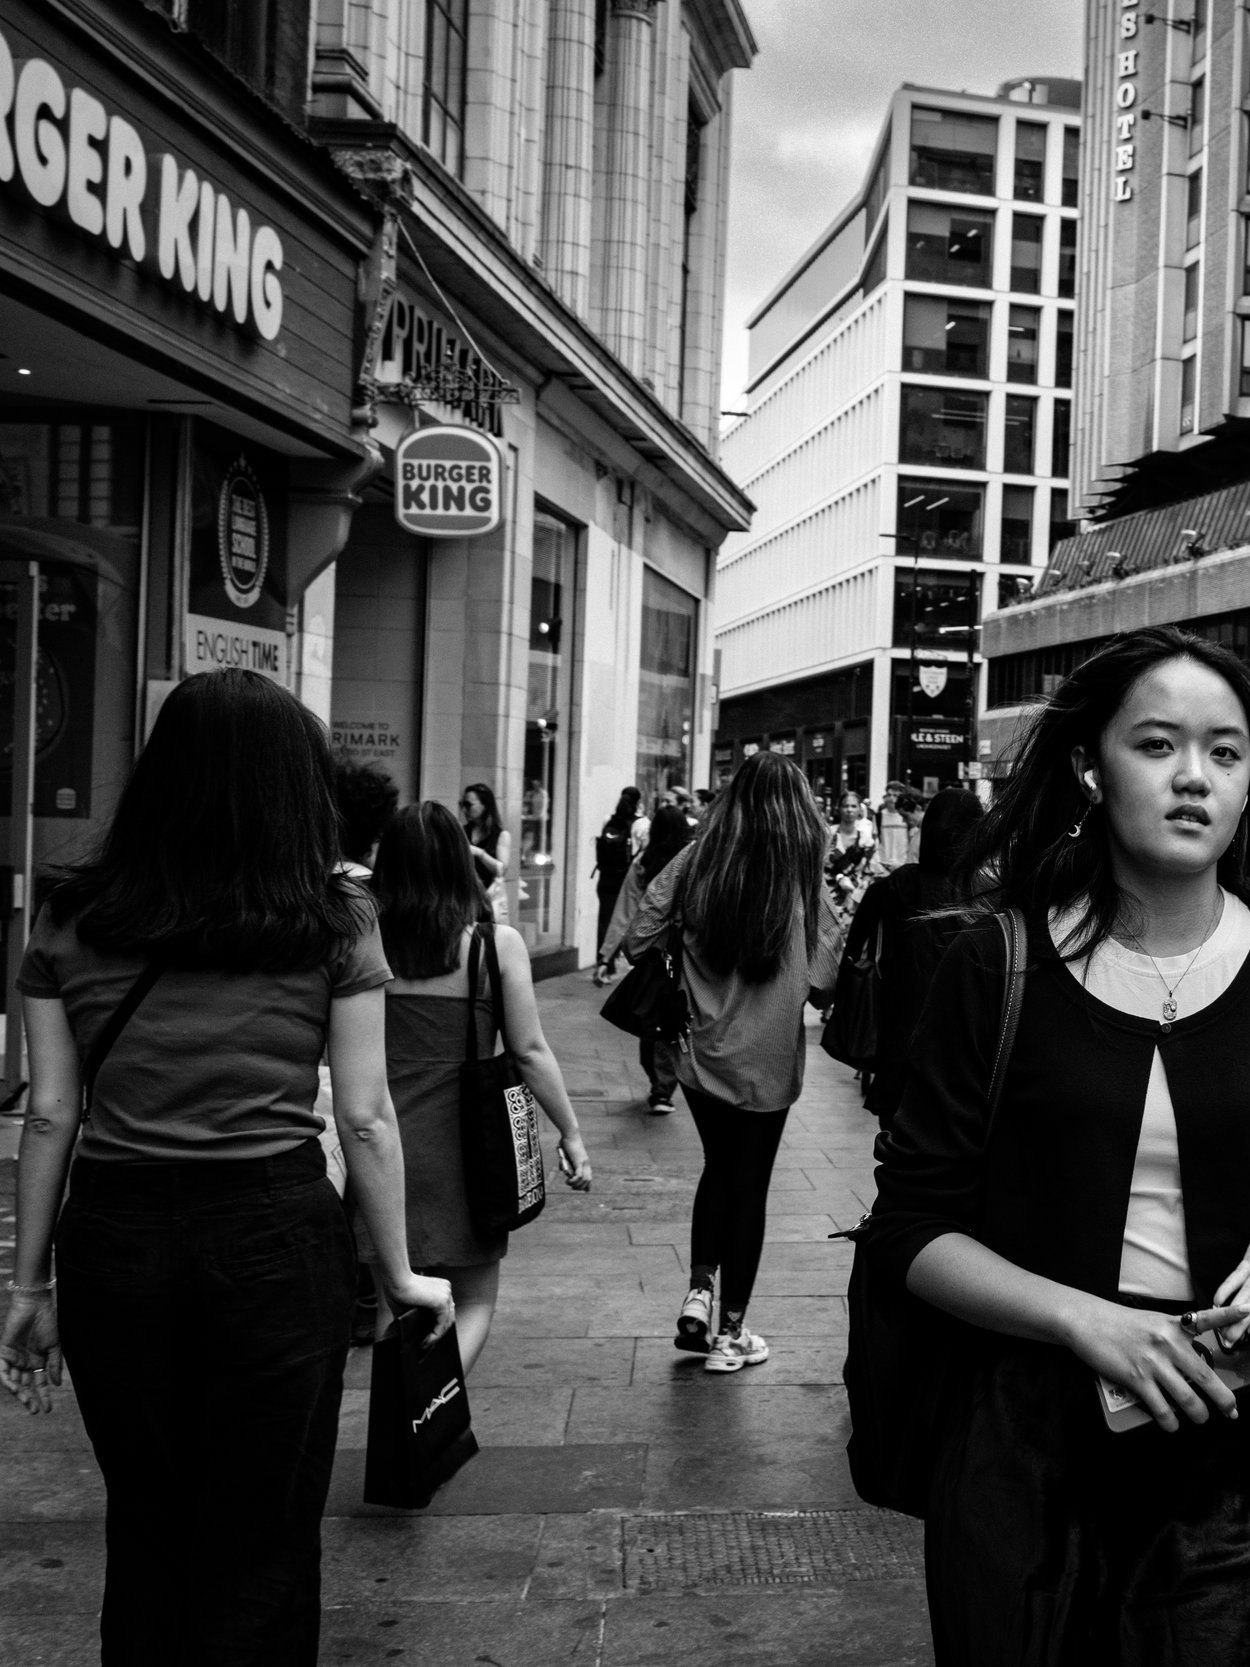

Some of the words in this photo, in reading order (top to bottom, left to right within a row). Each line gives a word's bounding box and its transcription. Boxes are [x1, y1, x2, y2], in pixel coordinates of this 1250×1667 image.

[1114, 50, 1139, 203] HOTEL
[158, 153, 284, 341] KING
[402, 462, 492, 484] BURGER
[402, 482, 492, 513] KING
[196, 630, 250, 667] ENGLISH
[251, 640, 279, 672] TIME
[332, 731, 401, 747] RIMARK
[378, 721, 389, 731] TO
